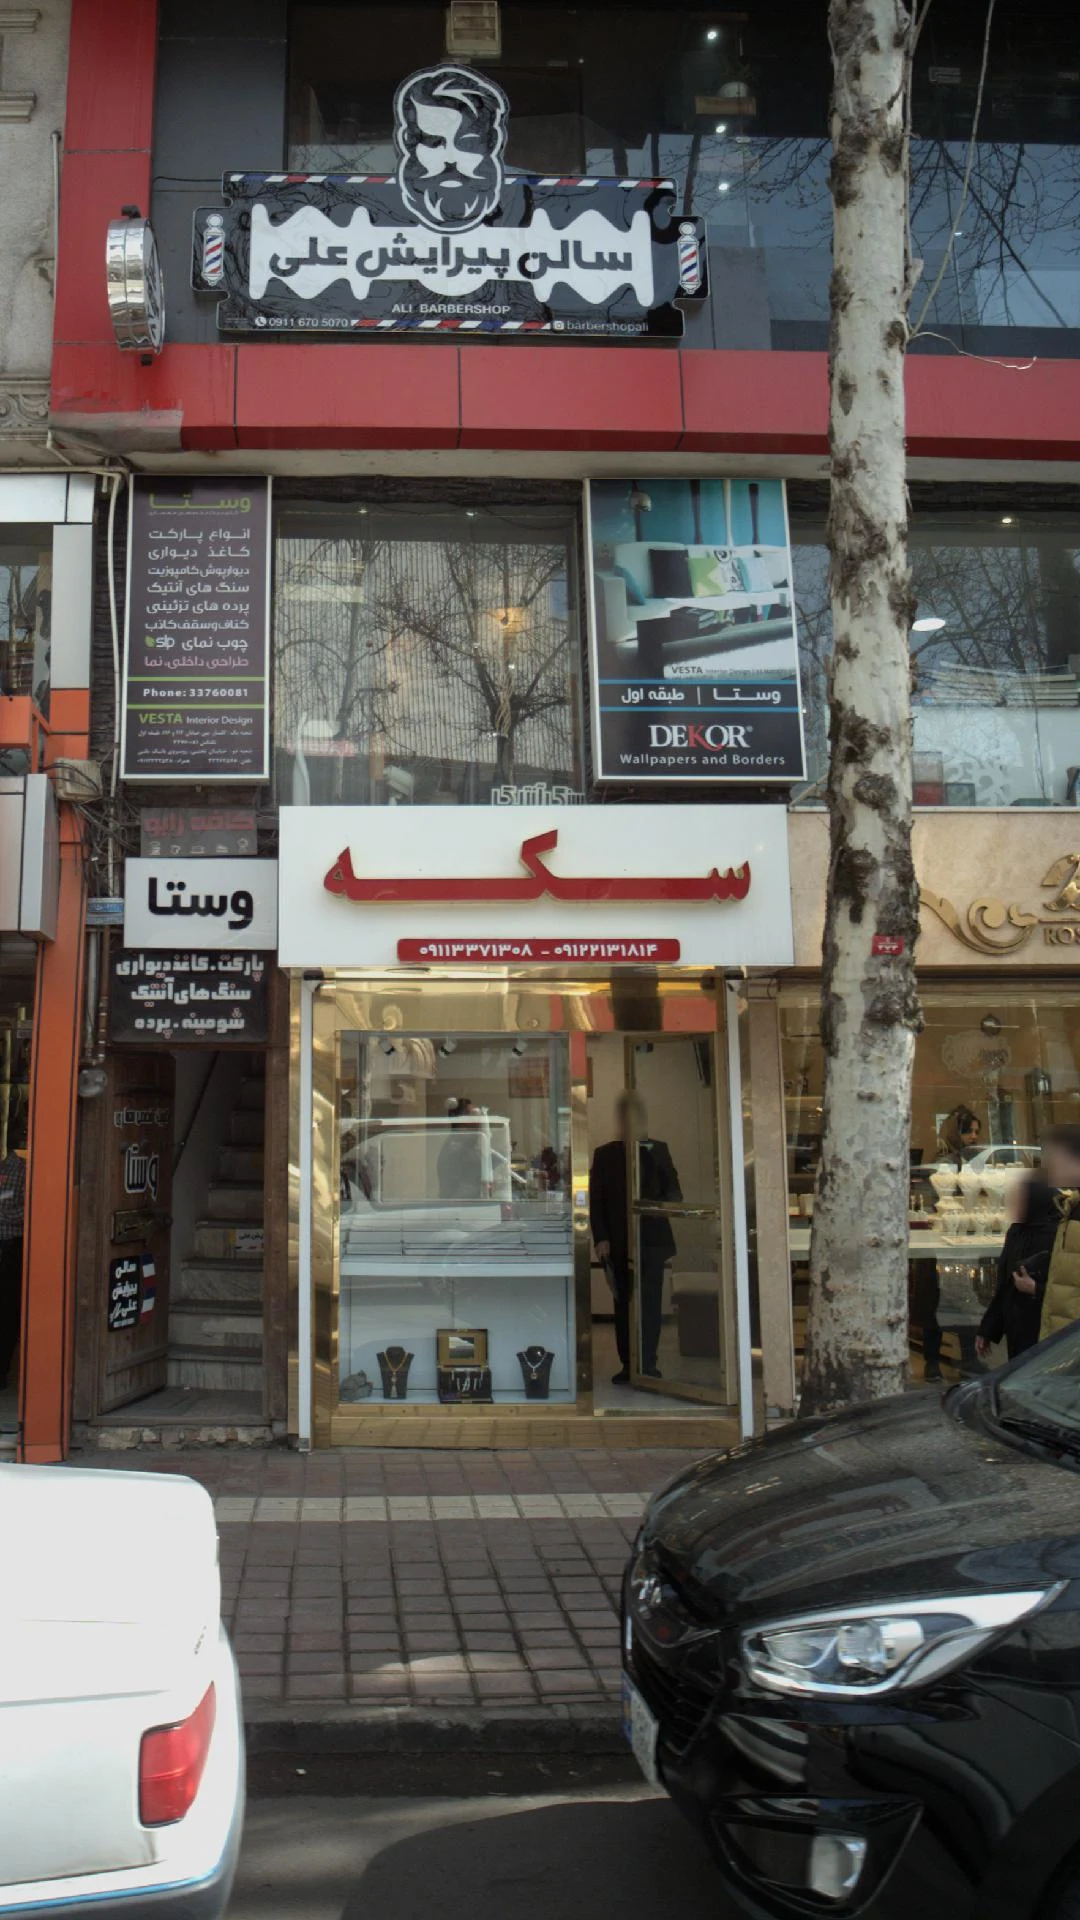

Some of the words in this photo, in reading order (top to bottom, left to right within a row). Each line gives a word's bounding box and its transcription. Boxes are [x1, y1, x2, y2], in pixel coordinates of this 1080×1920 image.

[268, 237, 348, 278] علی
[356, 232, 511, 278] پیرایش
[517, 239, 633, 280] سالن
[391, 303, 412, 313] ALI
[420, 304, 511, 315] BARBERSHOP
[269, 318, 294, 327] 0911
[299, 318, 318, 327] 670
[321, 318, 348, 327] 5070
[567, 319, 649, 332] barbershopali
[149, 493, 251, 512] وستا
[148, 528, 203, 544] پارکت
[208, 528, 250, 541] انواع
[148, 546, 197, 560] دیواری
[208, 546, 250, 557] کاغذ
[146, 580, 184, 596] آنتیک
[185, 582, 212, 596] های
[215, 581, 250, 593] سنگ
[192, 600, 218, 614] های
[222, 602, 250, 616] پرده
[217, 638, 248, 653] چوب
[671, 666, 704, 675] VESTA
[143, 688, 186, 697] Phone:
[189, 688, 249, 697] 33760081
[621, 688, 643, 704] اول
[648, 687, 685, 705] طبقه
[713, 687, 782, 704] وستا
[139, 713, 184, 724] VESTA
[186, 716, 219, 725] Interior
[221, 716, 253, 726] Design
[648, 725, 751, 751] DEKOR
[619, 754, 697, 767] Wallpapers
[701, 754, 727, 765] and
[732, 754, 786, 765] Borders
[148, 877, 254, 930] وستا
[173, 982, 209, 1005] های
[211, 981, 251, 1000] سنگ
[181, 1007, 245, 1035] شومینه
[134, 1018, 173, 1040] پرده
